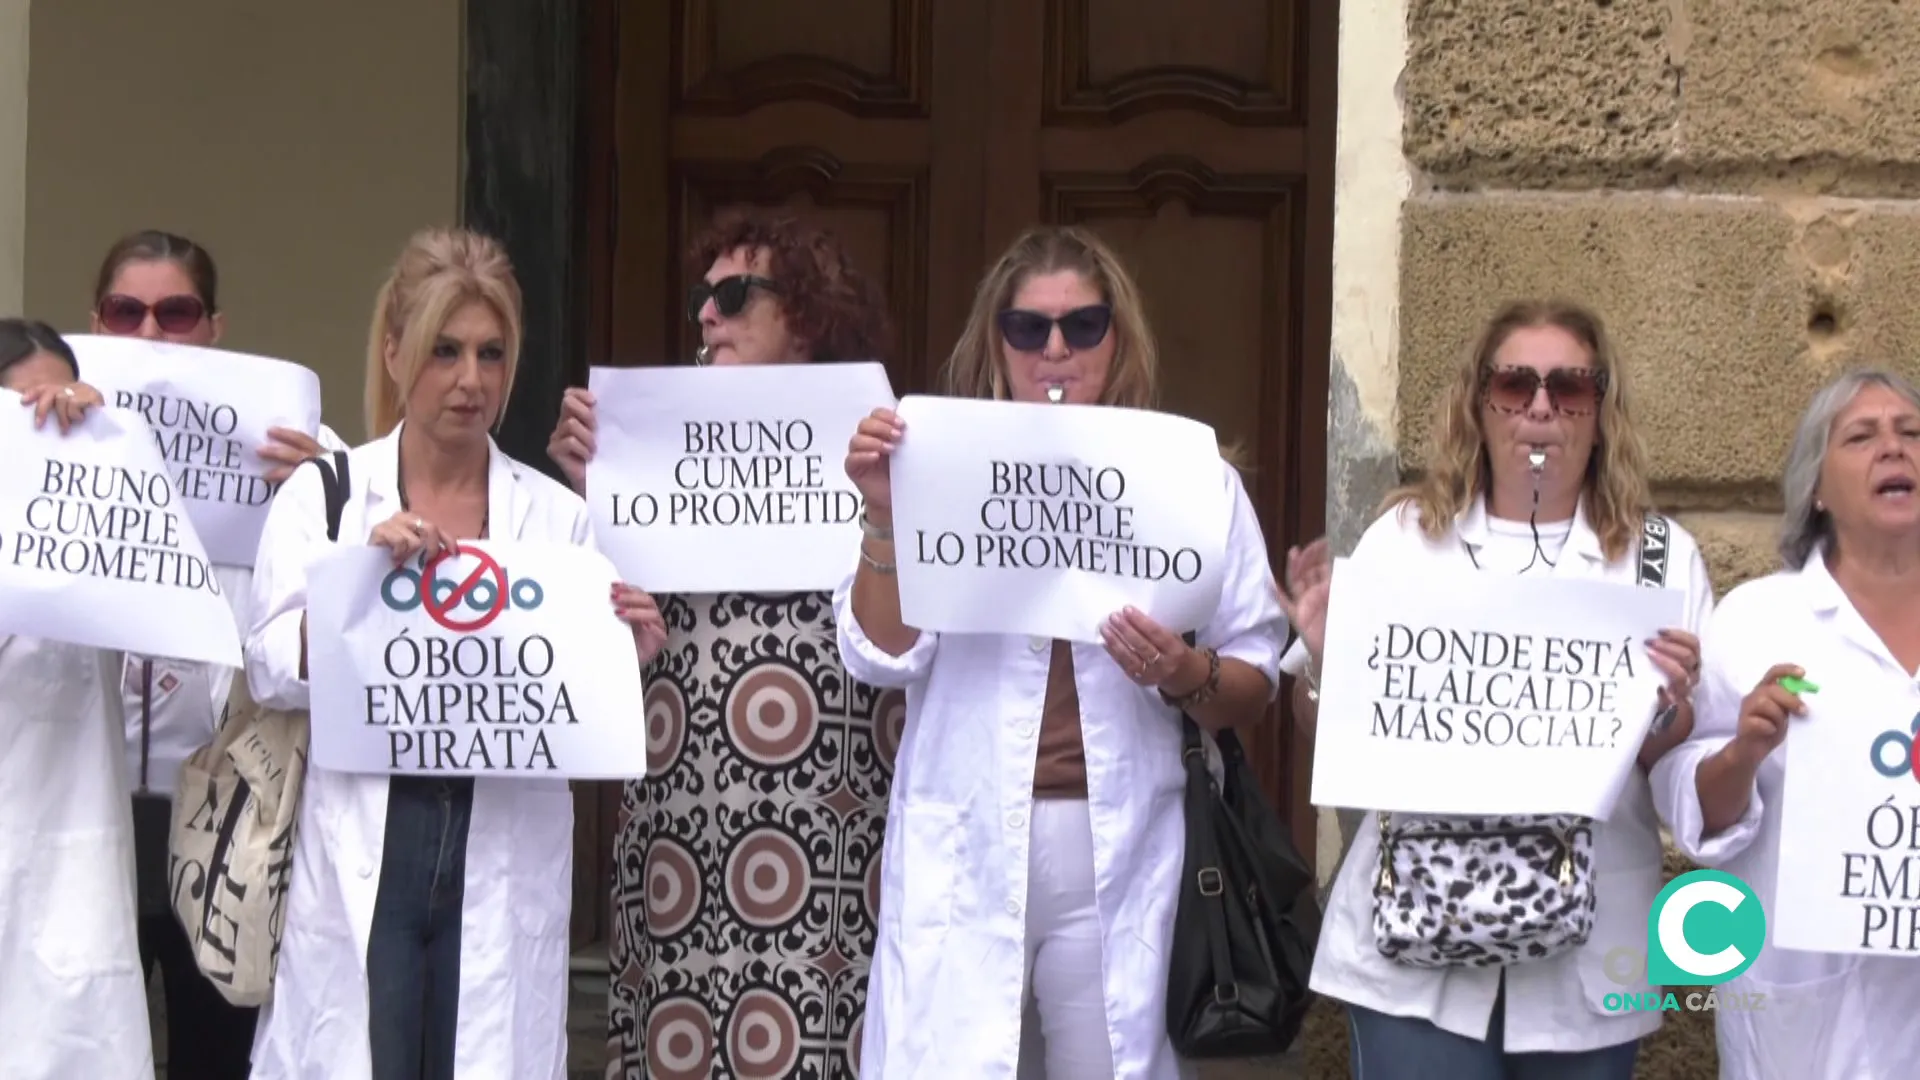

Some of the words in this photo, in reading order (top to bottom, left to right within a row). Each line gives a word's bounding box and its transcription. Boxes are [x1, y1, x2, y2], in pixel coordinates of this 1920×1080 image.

[153, 427, 243, 470] MPLE
[683, 418, 814, 454] BRUNO
[41, 457, 172, 509] BRUNO
[673, 455, 825, 490] CUMPLE
[989, 460, 1126, 502] BRUNO
[25, 495, 182, 549] CUMPLE
[611, 493, 659, 527] LO
[668, 489, 865, 527] PROMETID
[980, 497, 1135, 541] CUMPLE
[11, 530, 222, 597] PROMETIDO
[916, 530, 966, 566] LO
[974, 532, 1203, 584] PROMETIDO
[382, 628, 555, 679] ÓBOLO
[1366, 622, 1533, 671] ¿DONDE
[1542, 636, 1636, 678] ESTÁ
[363, 681, 580, 727] EMPRESA
[1382, 663, 1428, 703] EL
[1433, 667, 1619, 713] ALCALDE
[386, 727, 558, 771] PIRATA
[1462, 708, 1624, 749] SOCIAL?
